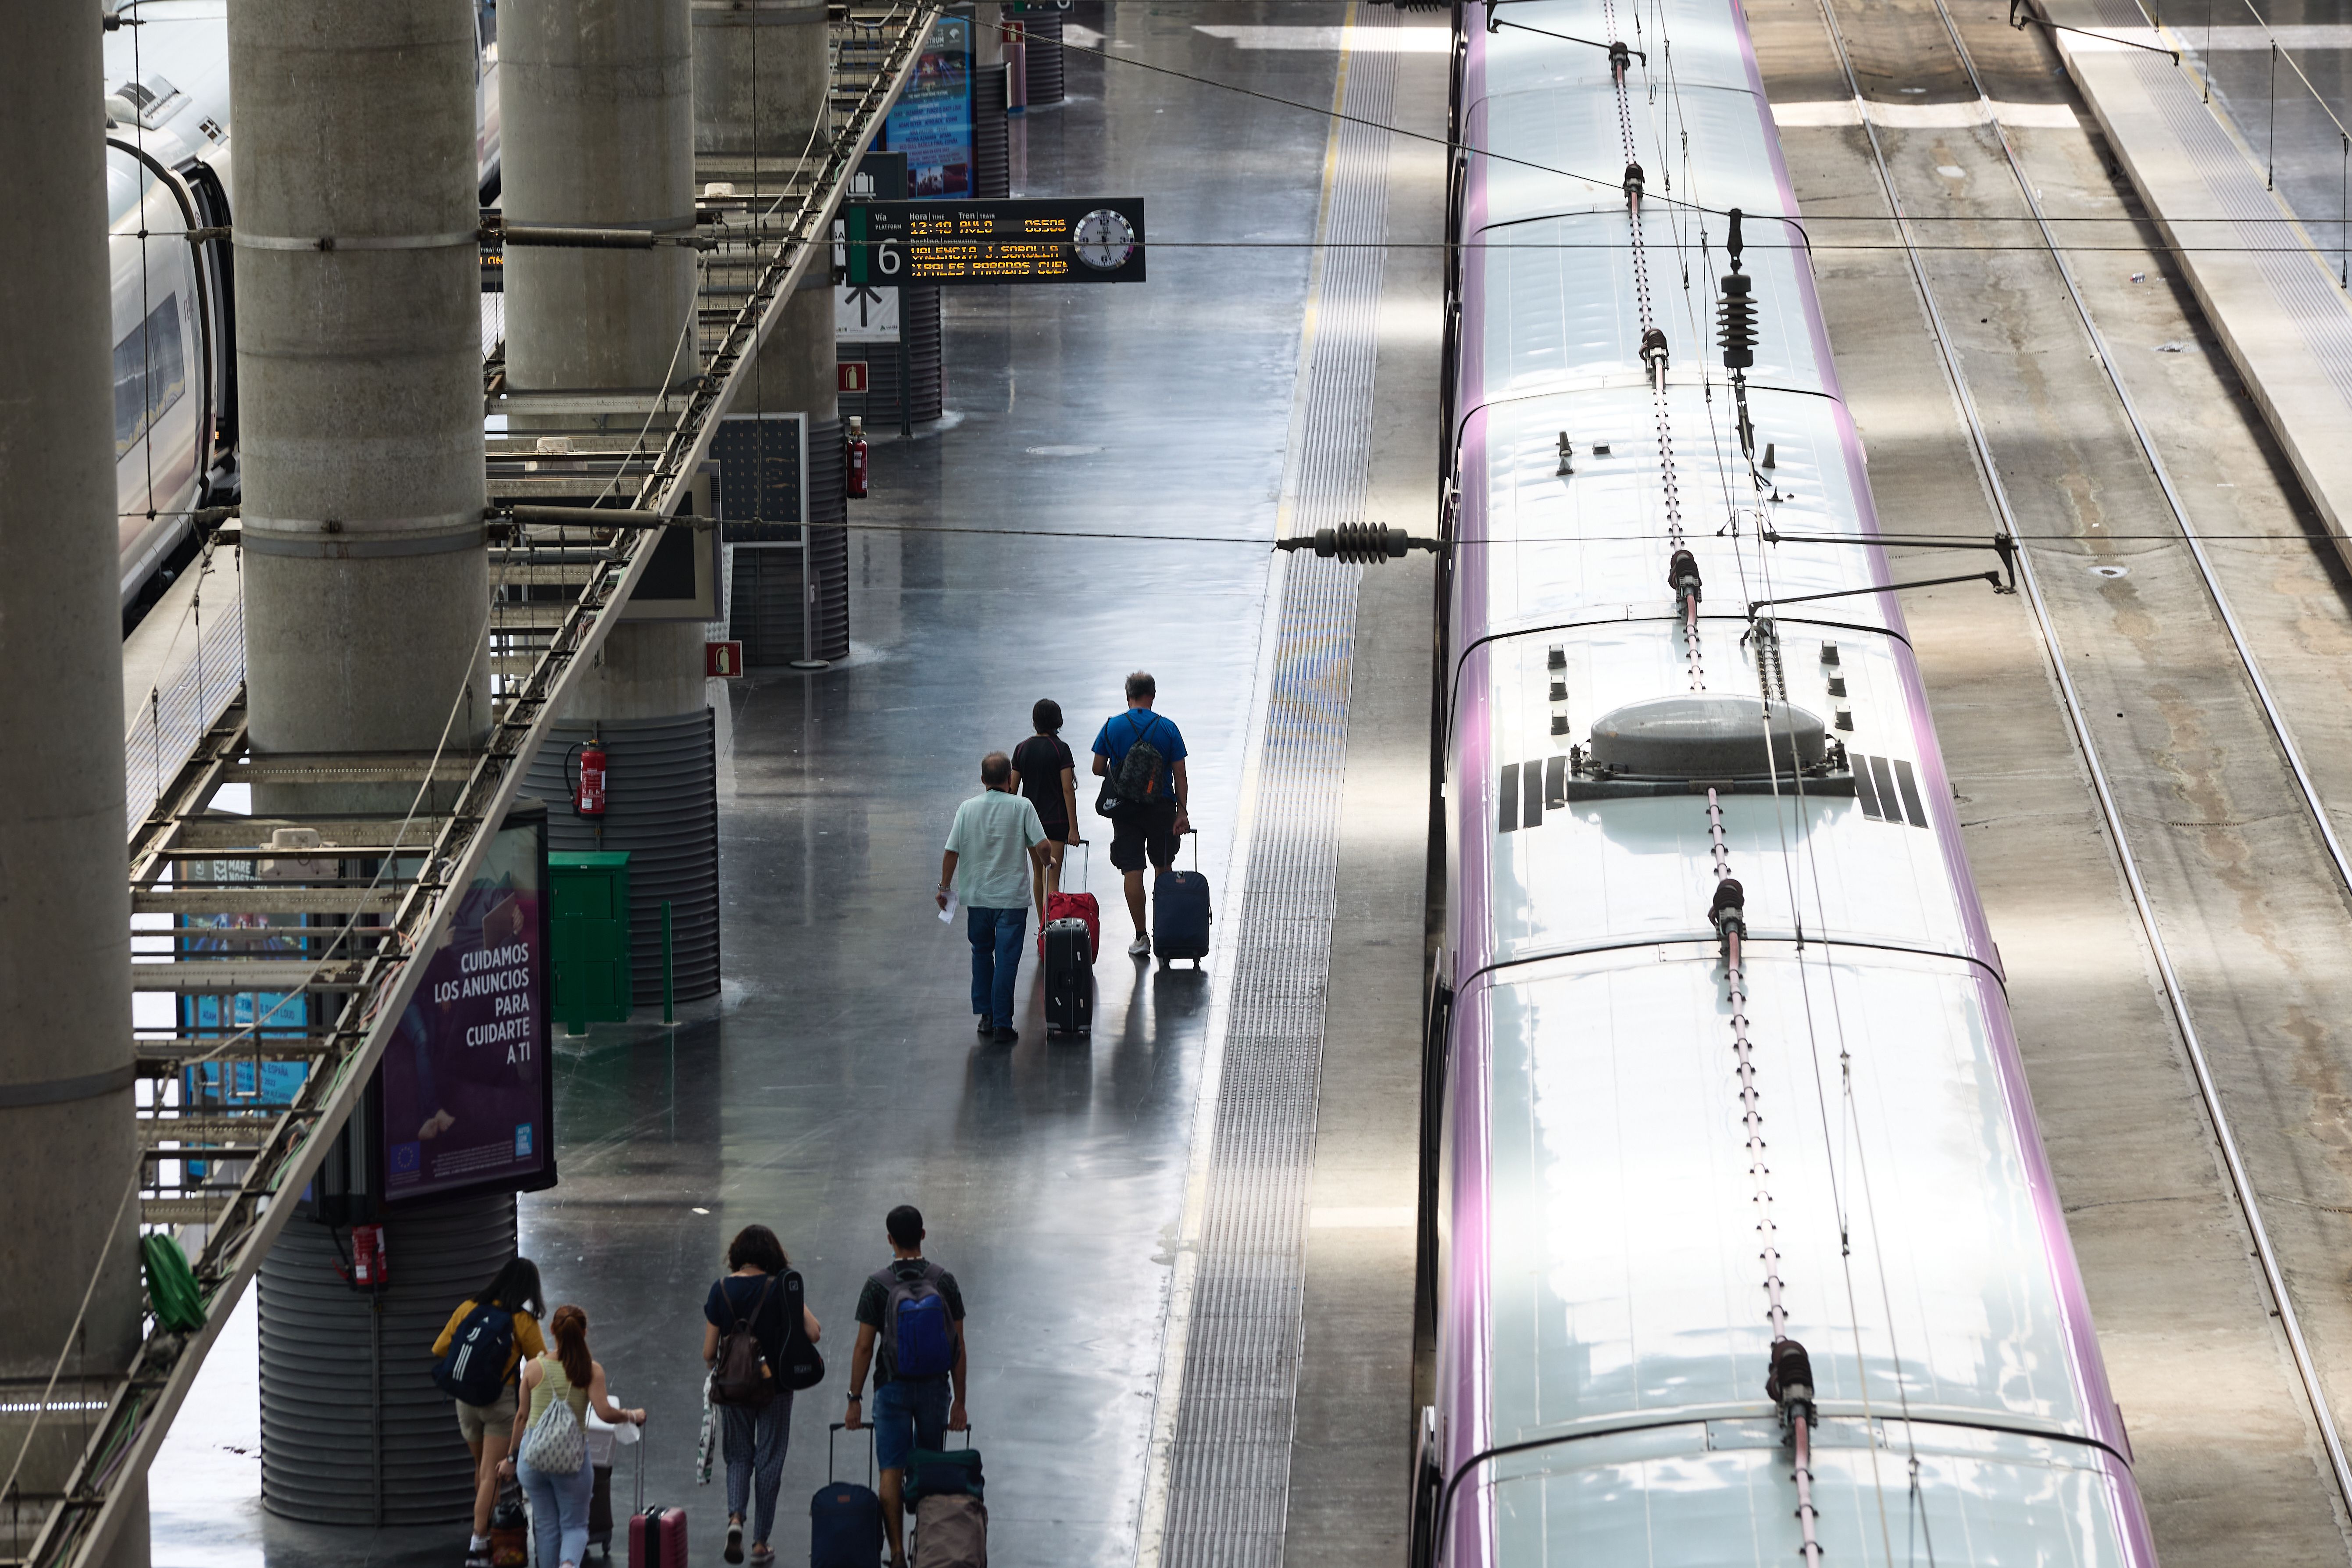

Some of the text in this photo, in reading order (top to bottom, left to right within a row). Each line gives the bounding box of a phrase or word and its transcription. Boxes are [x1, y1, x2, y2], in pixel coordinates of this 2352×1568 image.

[875, 212, 887, 221] Vía
[878, 238, 900, 275] 6
[228, 860, 251, 874] MARE
[461, 943, 529, 973] CUIDAMOS
[435, 967, 529, 1003] LOS ANUNCIOS
[495, 992, 529, 1017] PARA
[466, 1017, 529, 1047] CUIDARTE
[507, 1041, 530, 1064] A TI
